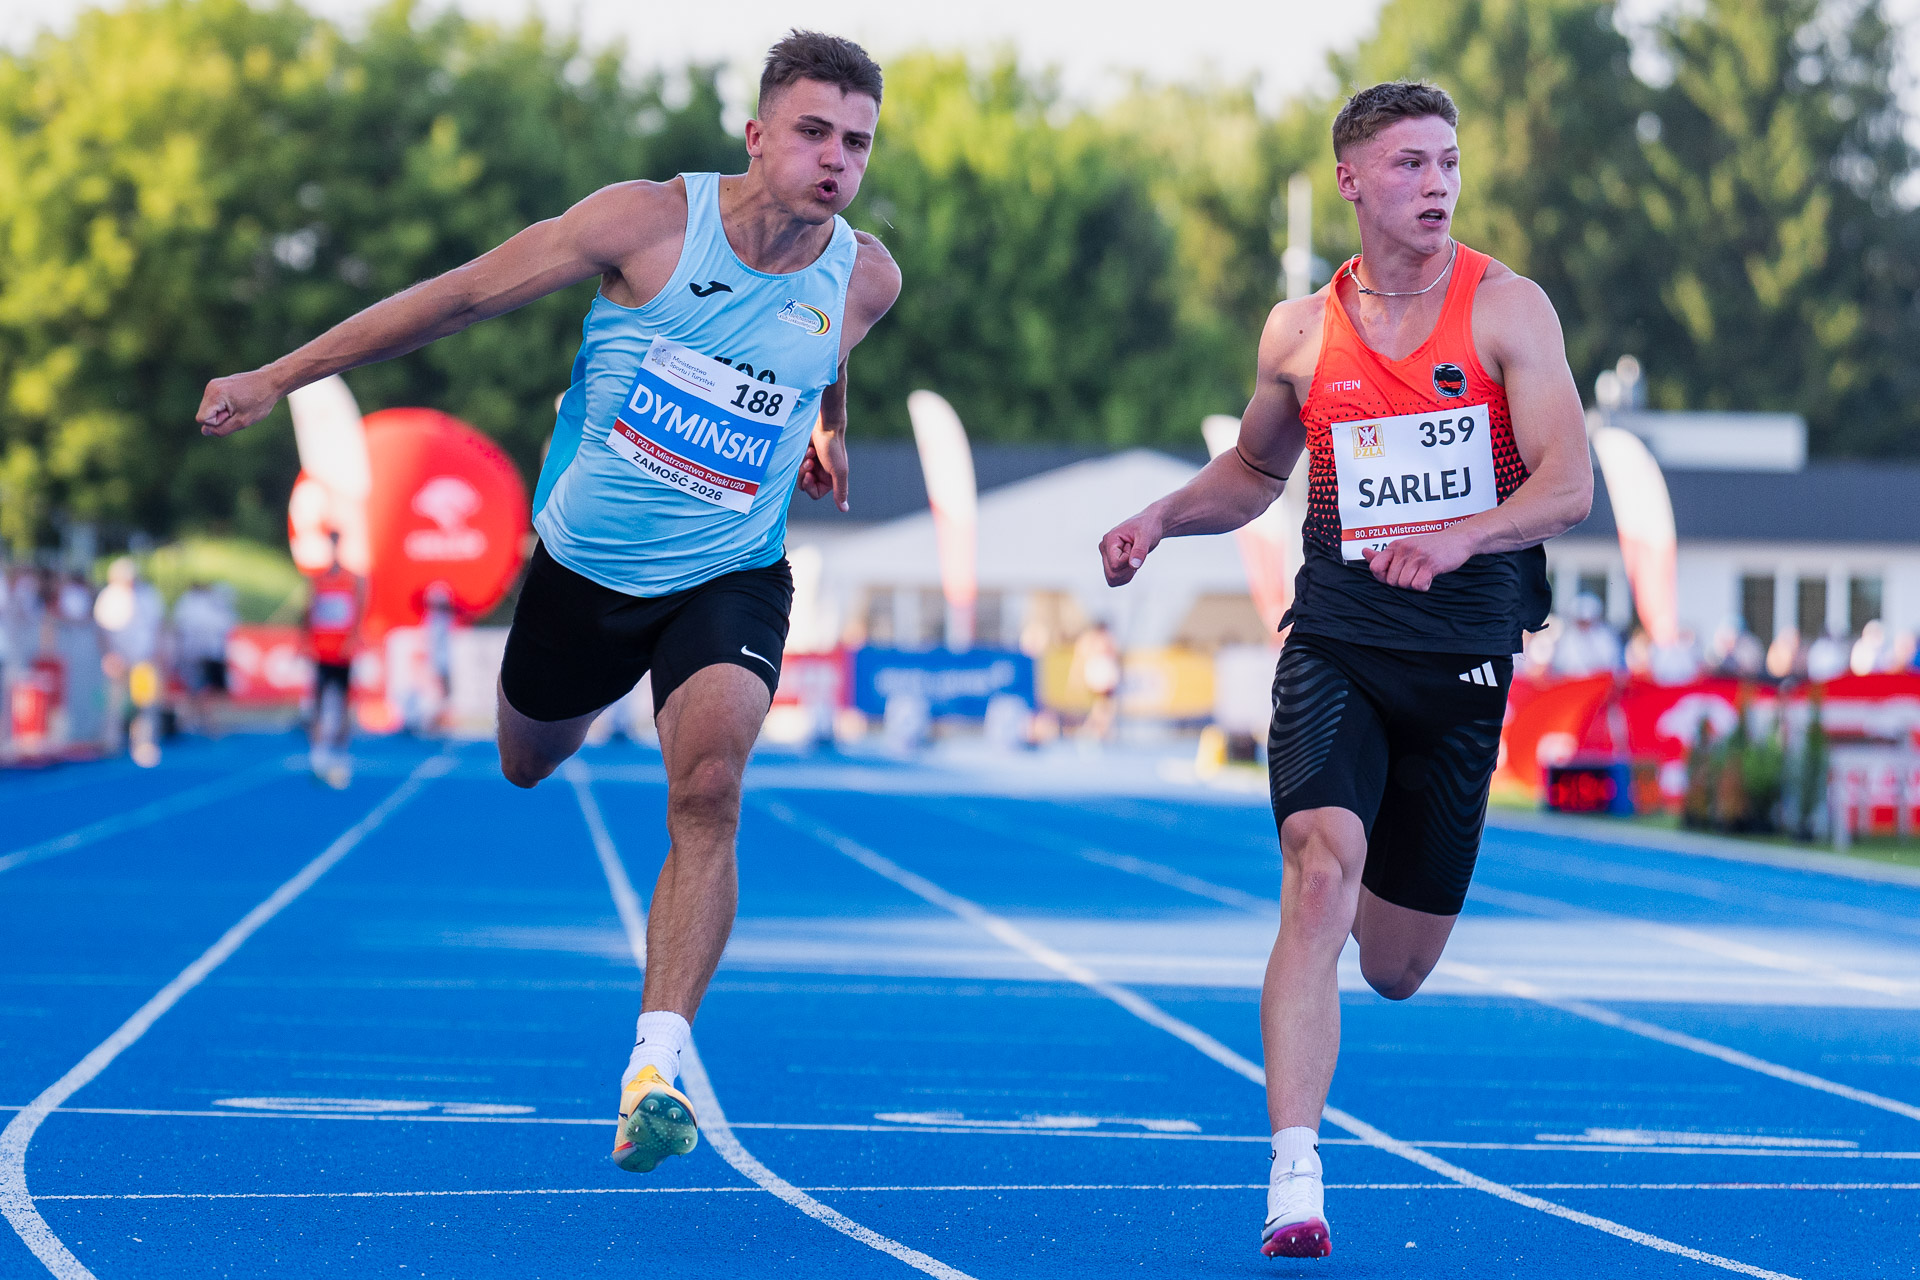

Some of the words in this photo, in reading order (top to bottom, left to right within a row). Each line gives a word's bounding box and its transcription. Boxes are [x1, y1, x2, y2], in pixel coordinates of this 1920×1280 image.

[670, 361, 688, 375] Sportu
[691, 372, 716, 387] Turystyki
[672, 355, 707, 376] Ministerstwo
[730, 384, 784, 417] 188
[628, 383, 772, 467] DYMIŃSKI
[1419, 416, 1475, 448] 359
[624, 429, 636, 442] 80.
[636, 438, 655, 453] PZLA
[655, 450, 705, 477] Mistrzostwa
[705, 472, 730, 487] Polski
[729, 481, 746, 491] U20
[1355, 447, 1383, 457] PZLA
[633, 451, 689, 487] ZAMOŚĆ
[689, 481, 723, 501] 2026
[1358, 466, 1472, 508] SARLEJ
[1354, 530, 1368, 539] 80.
[1368, 527, 1388, 537] PZLA
[1389, 522, 1442, 535] Mistrzostwa
